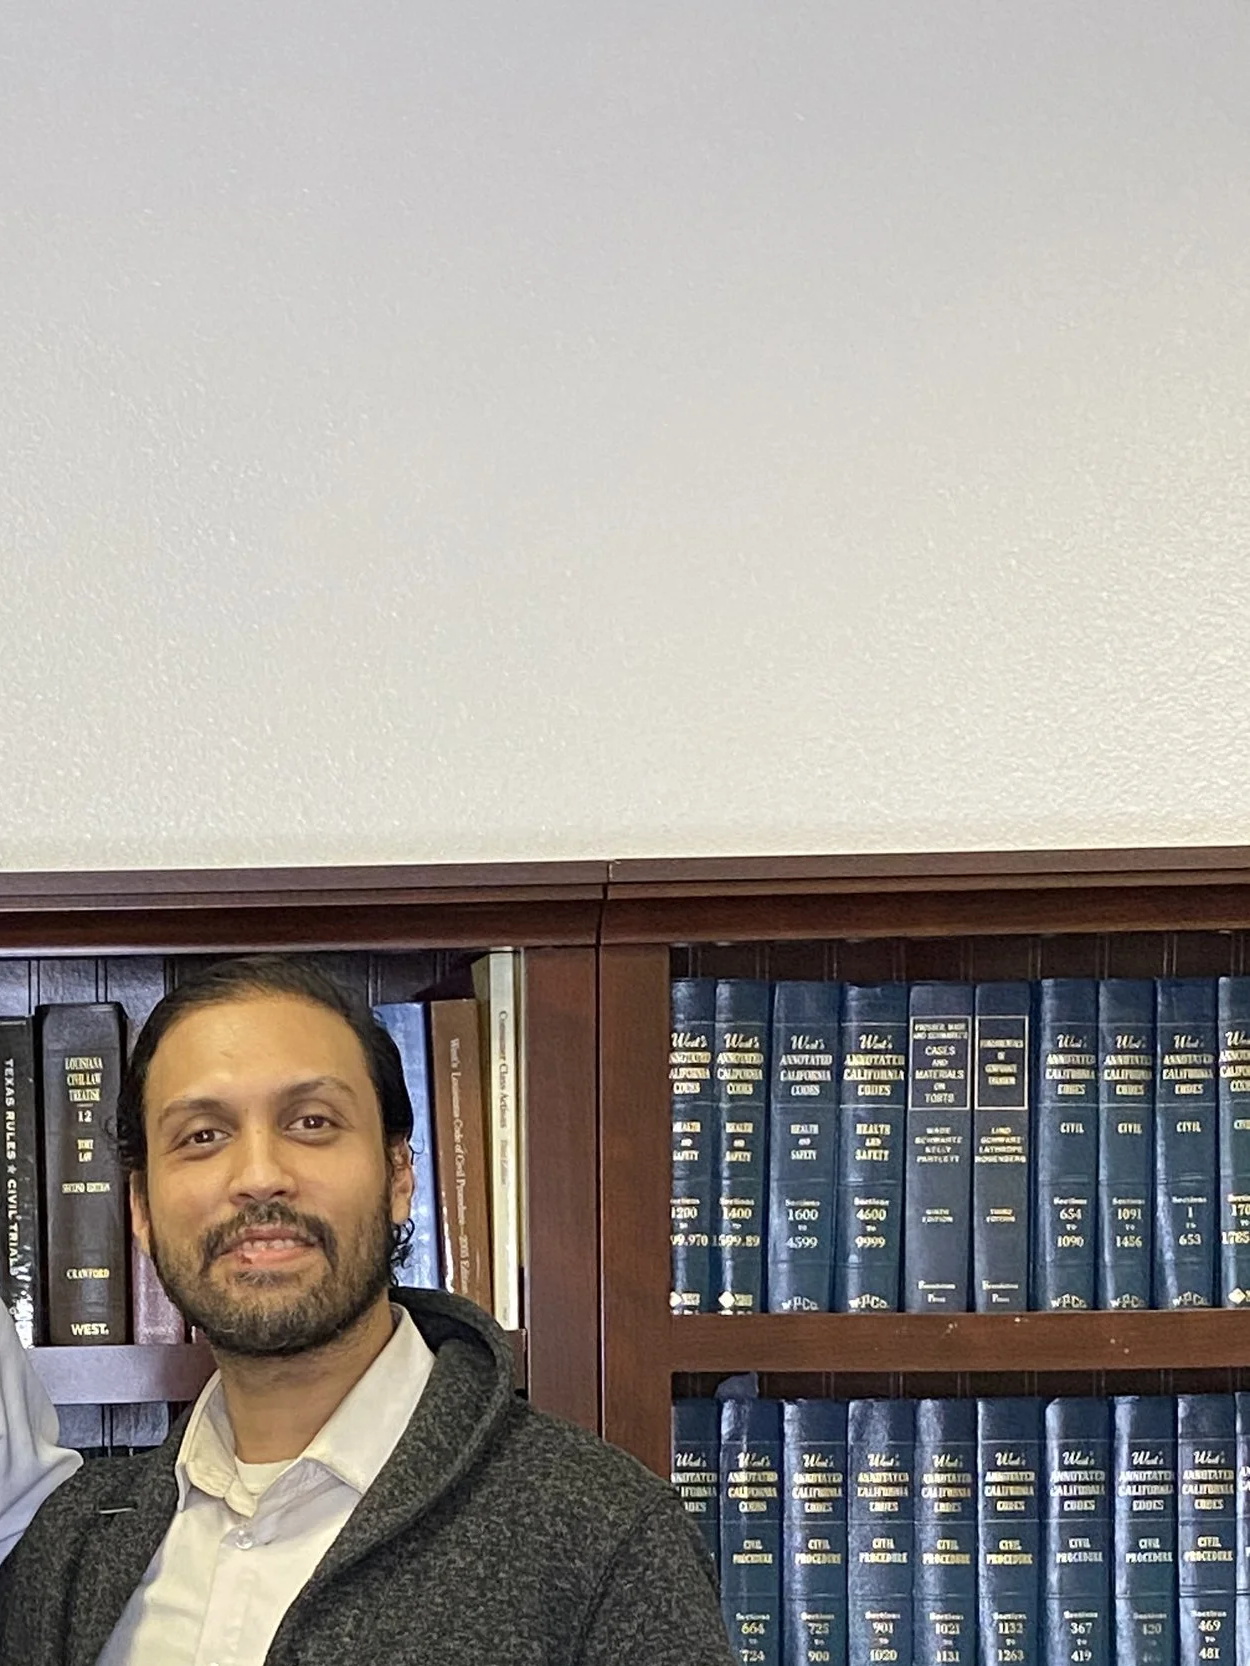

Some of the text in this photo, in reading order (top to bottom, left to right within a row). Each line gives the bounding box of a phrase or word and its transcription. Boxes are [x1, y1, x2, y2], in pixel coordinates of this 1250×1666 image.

[4, 1058, 15, 1106] TEXAS
[78, 1111, 92, 1123] 12
[1060, 1122, 1084, 1133] CIVIL
[1177, 1121, 1201, 1132] CIVIL
[5, 1111, 16, 1160] RULES
[7, 1179, 17, 1219] CIVIL
[787, 1209, 819, 1221] 1600
[1117, 1208, 1142, 1220] 1091
[787, 1236, 818, 1248] 4599
[1057, 1236, 1084, 1248] 1090
[66, 1268, 110, 1279] CRAWFORD
[1071, 1623, 1093, 1634] 367
[1198, 1620, 1221, 1632] 469
[808, 1650, 830, 1662] 900
[1071, 1650, 1092, 1662] 419
